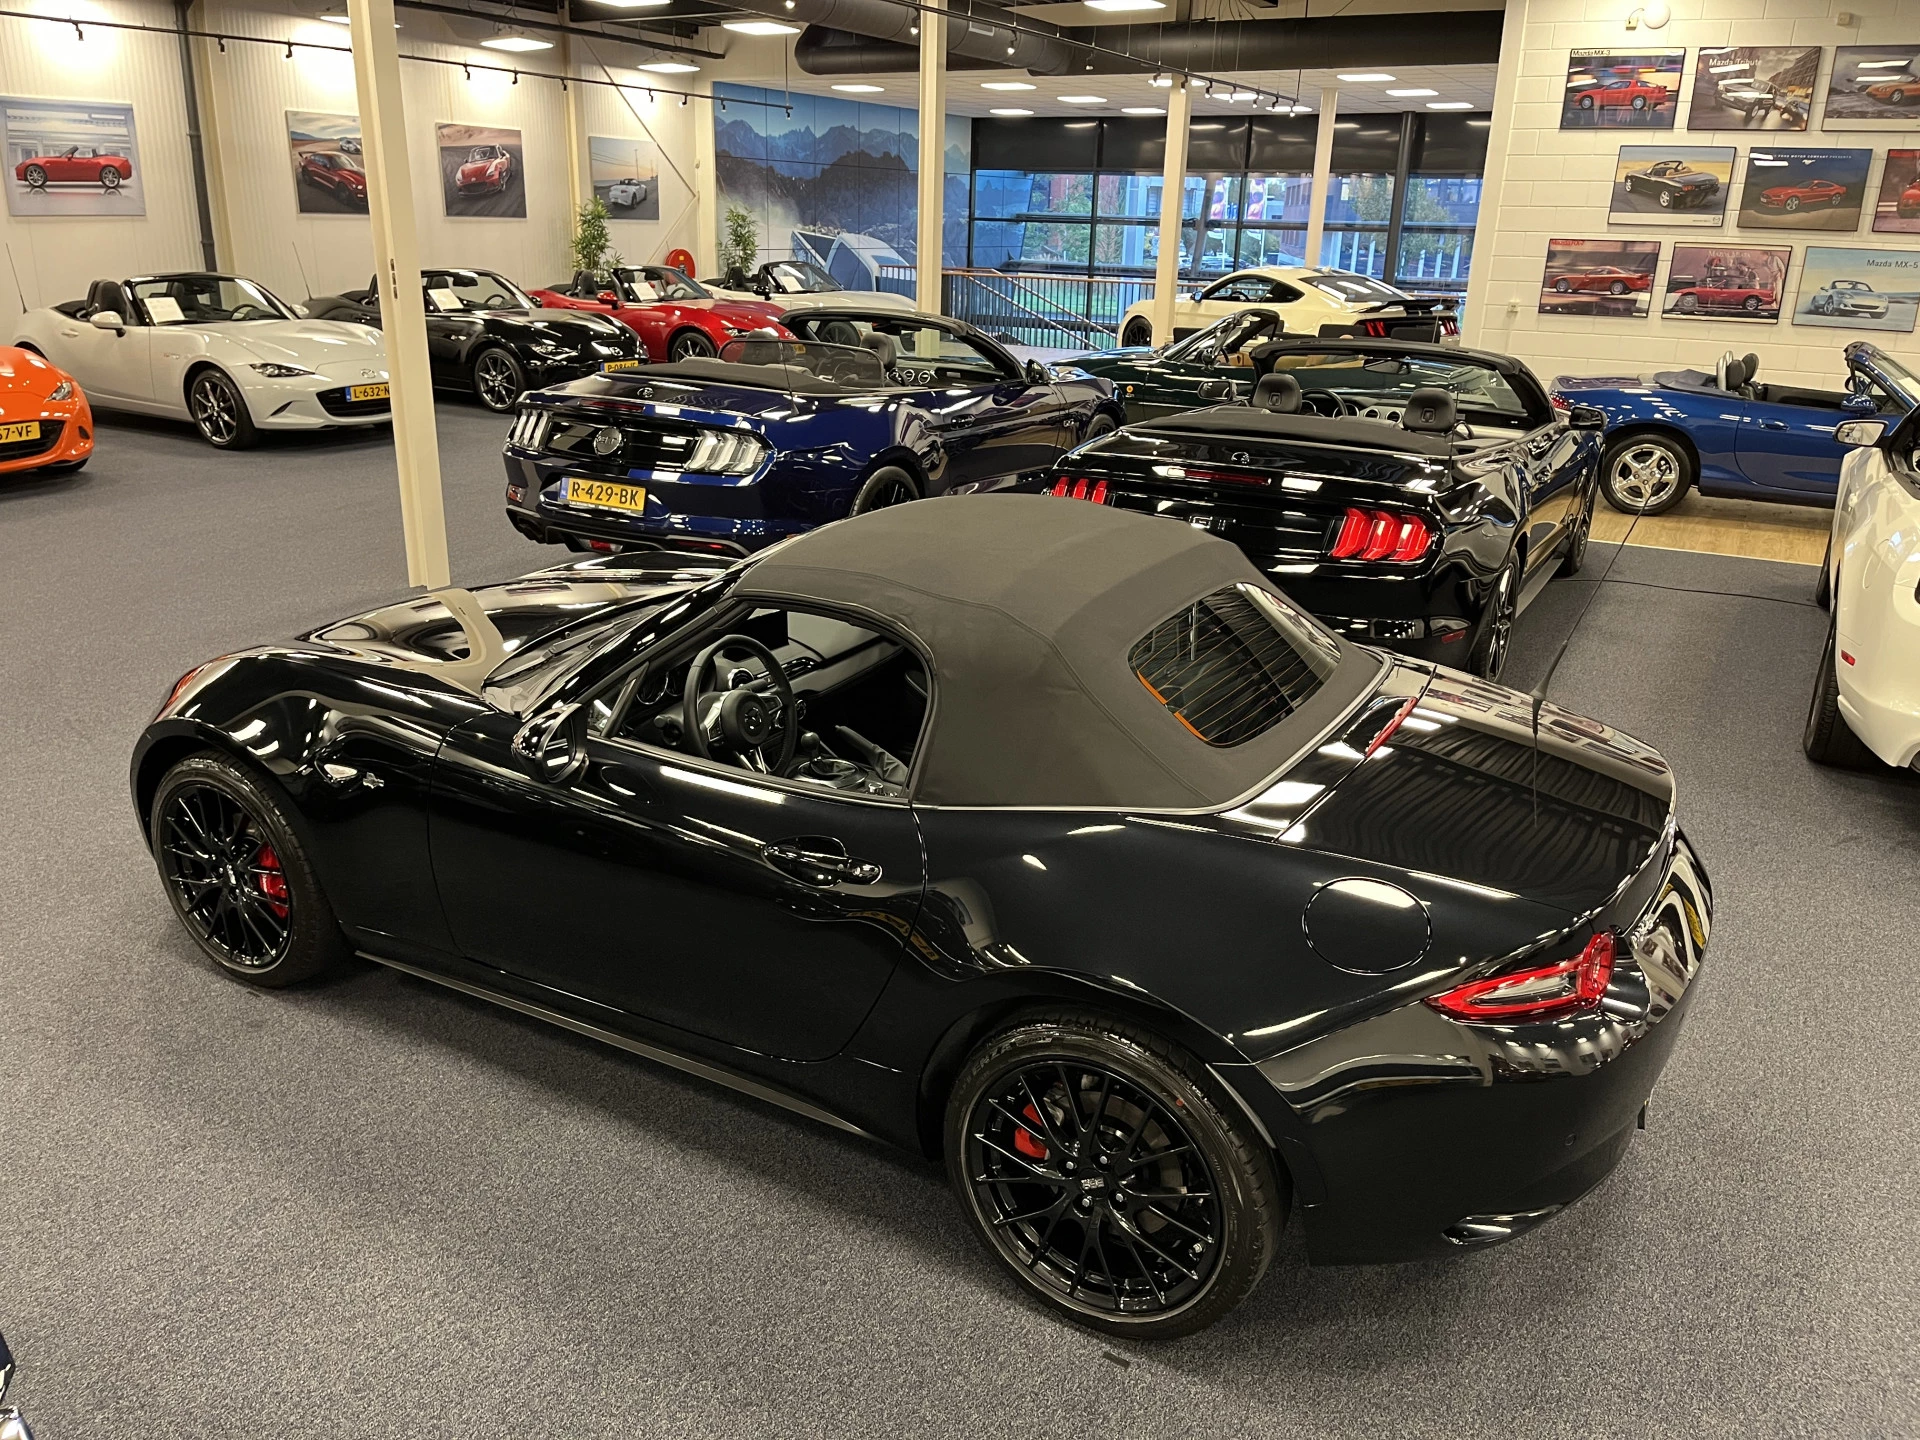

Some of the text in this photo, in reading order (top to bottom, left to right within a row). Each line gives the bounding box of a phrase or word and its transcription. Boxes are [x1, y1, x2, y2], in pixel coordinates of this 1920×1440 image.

[1709, 58, 1733, 66] Mazda
[1866, 259, 1919, 269] Mazda MX-5
[571, 481, 640, 507] R-429-BK
